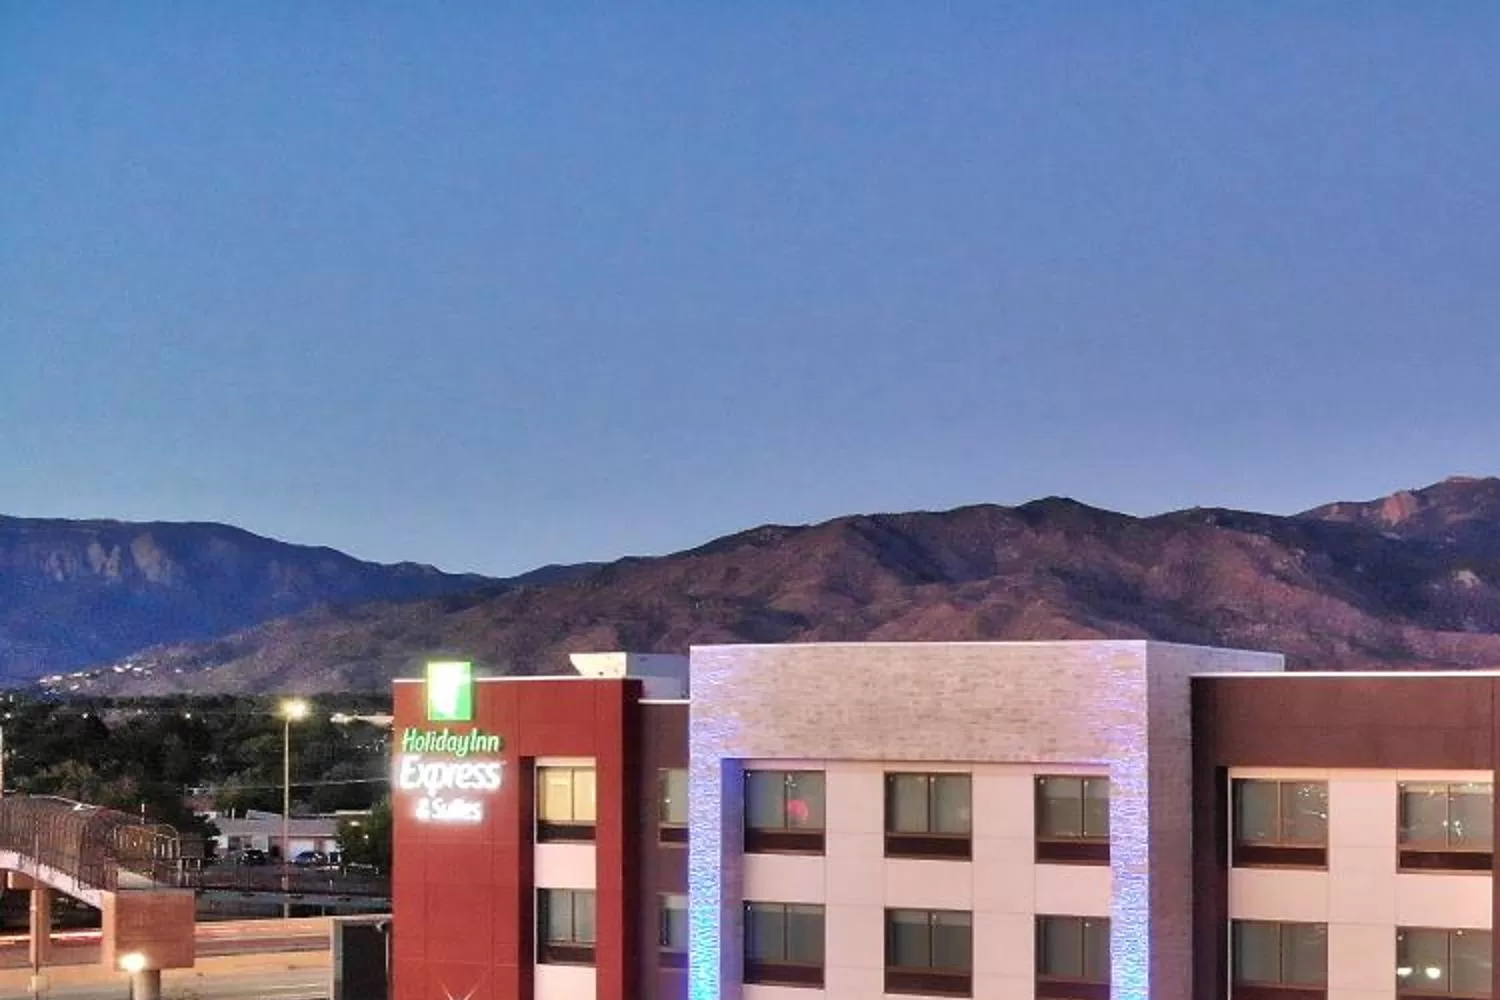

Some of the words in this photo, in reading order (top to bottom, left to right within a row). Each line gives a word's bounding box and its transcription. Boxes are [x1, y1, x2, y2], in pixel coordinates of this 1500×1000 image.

[400, 754, 502, 797] Express
[415, 798, 429, 821] &
[431, 797, 483, 822] Suites
